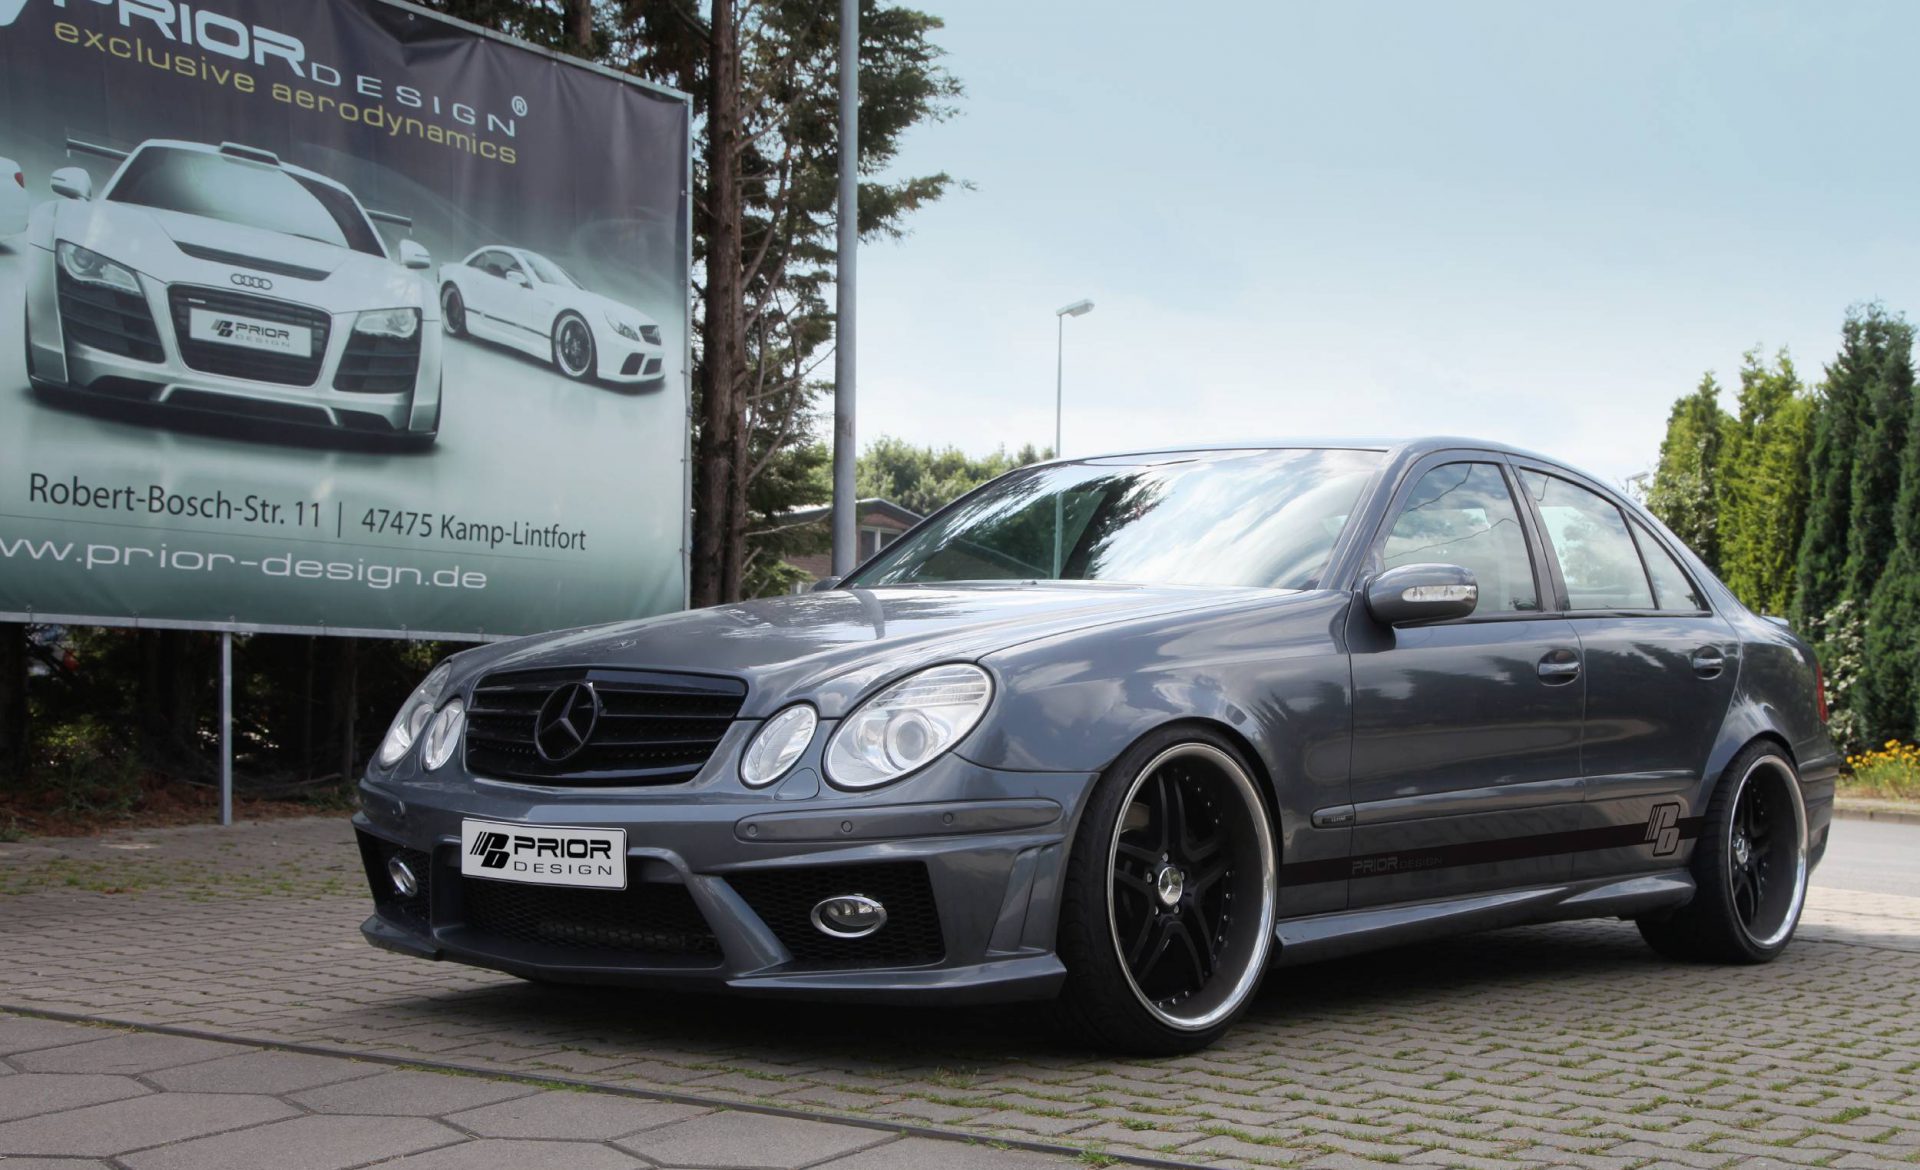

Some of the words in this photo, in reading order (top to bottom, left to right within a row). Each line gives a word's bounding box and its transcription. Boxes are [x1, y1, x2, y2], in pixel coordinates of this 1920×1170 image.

[54, 0, 305, 77] RIOR
[54, 22, 255, 93] exclusive
[272, 83, 516, 164] aerodynamics
[235, 322, 290, 340] PRIOR
[29, 473, 285, 525] Robert-Bosch-Str.
[295, 501, 320, 527] 11
[361, 508, 432, 538] 47475
[440, 514, 587, 550] Kamp-Lintfort
[514, 835, 611, 859] PRIOR
[514, 861, 612, 875] DESIGN
[1352, 856, 1398, 875] PRIOR
